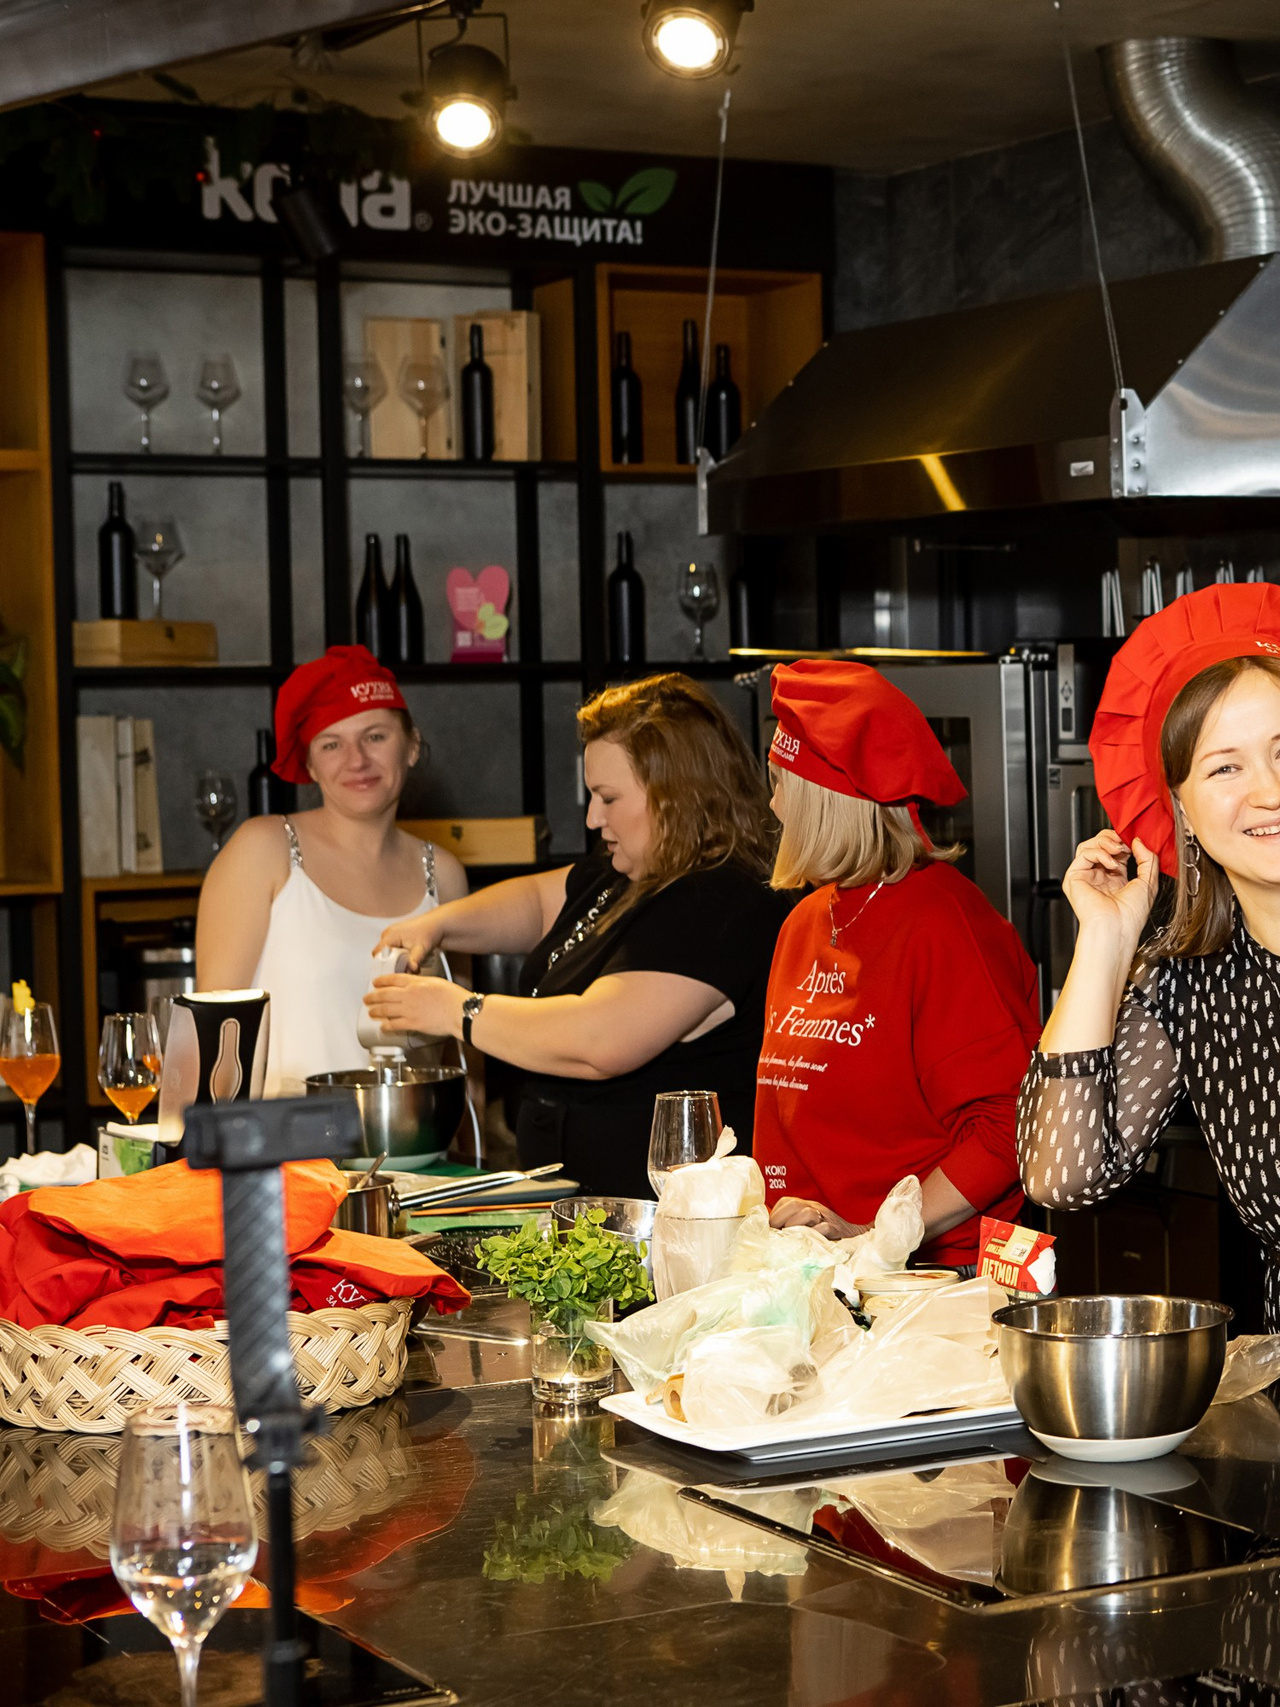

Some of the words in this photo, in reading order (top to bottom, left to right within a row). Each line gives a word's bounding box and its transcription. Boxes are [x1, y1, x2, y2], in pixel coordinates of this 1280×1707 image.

[448, 179, 571, 211] ЛУЧШАЯ
[448, 208, 643, 247] ЭКО-ЗАЩИТА!
[769, 1178, 787, 1189] 2024
